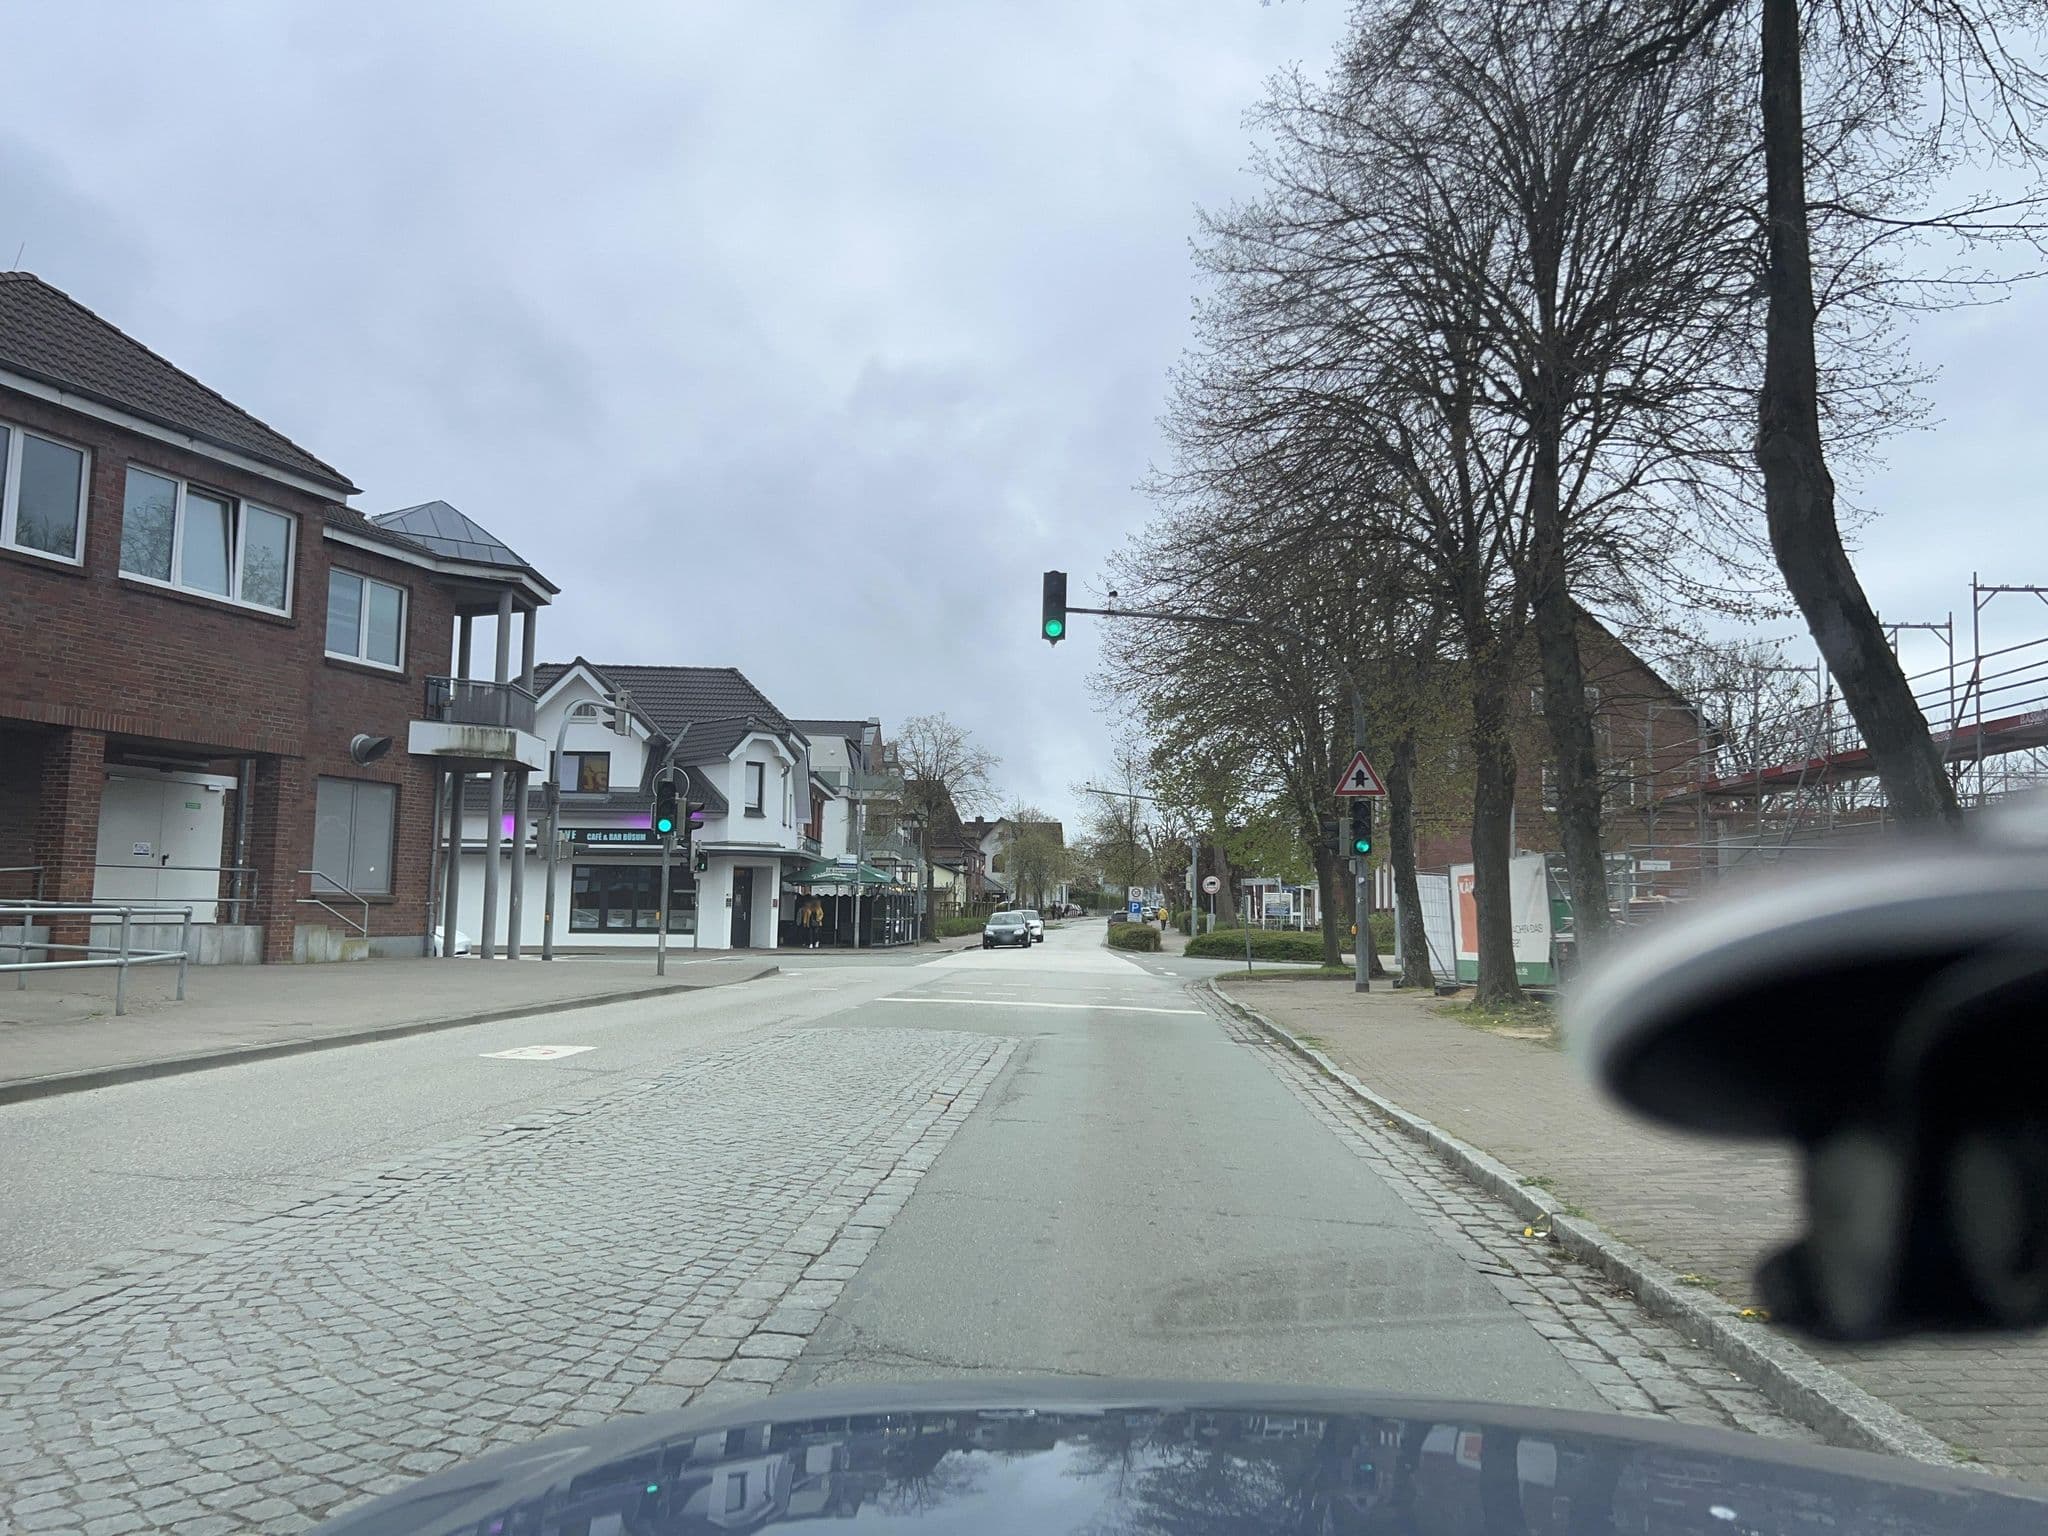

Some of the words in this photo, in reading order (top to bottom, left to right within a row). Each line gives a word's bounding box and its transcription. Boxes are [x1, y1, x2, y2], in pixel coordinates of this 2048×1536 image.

[587, 832, 602, 841] CAFÉ
[609, 833, 622, 841] BAR
[623, 832, 646, 841] BÜSUM
[1132, 903, 1139, 912] P
